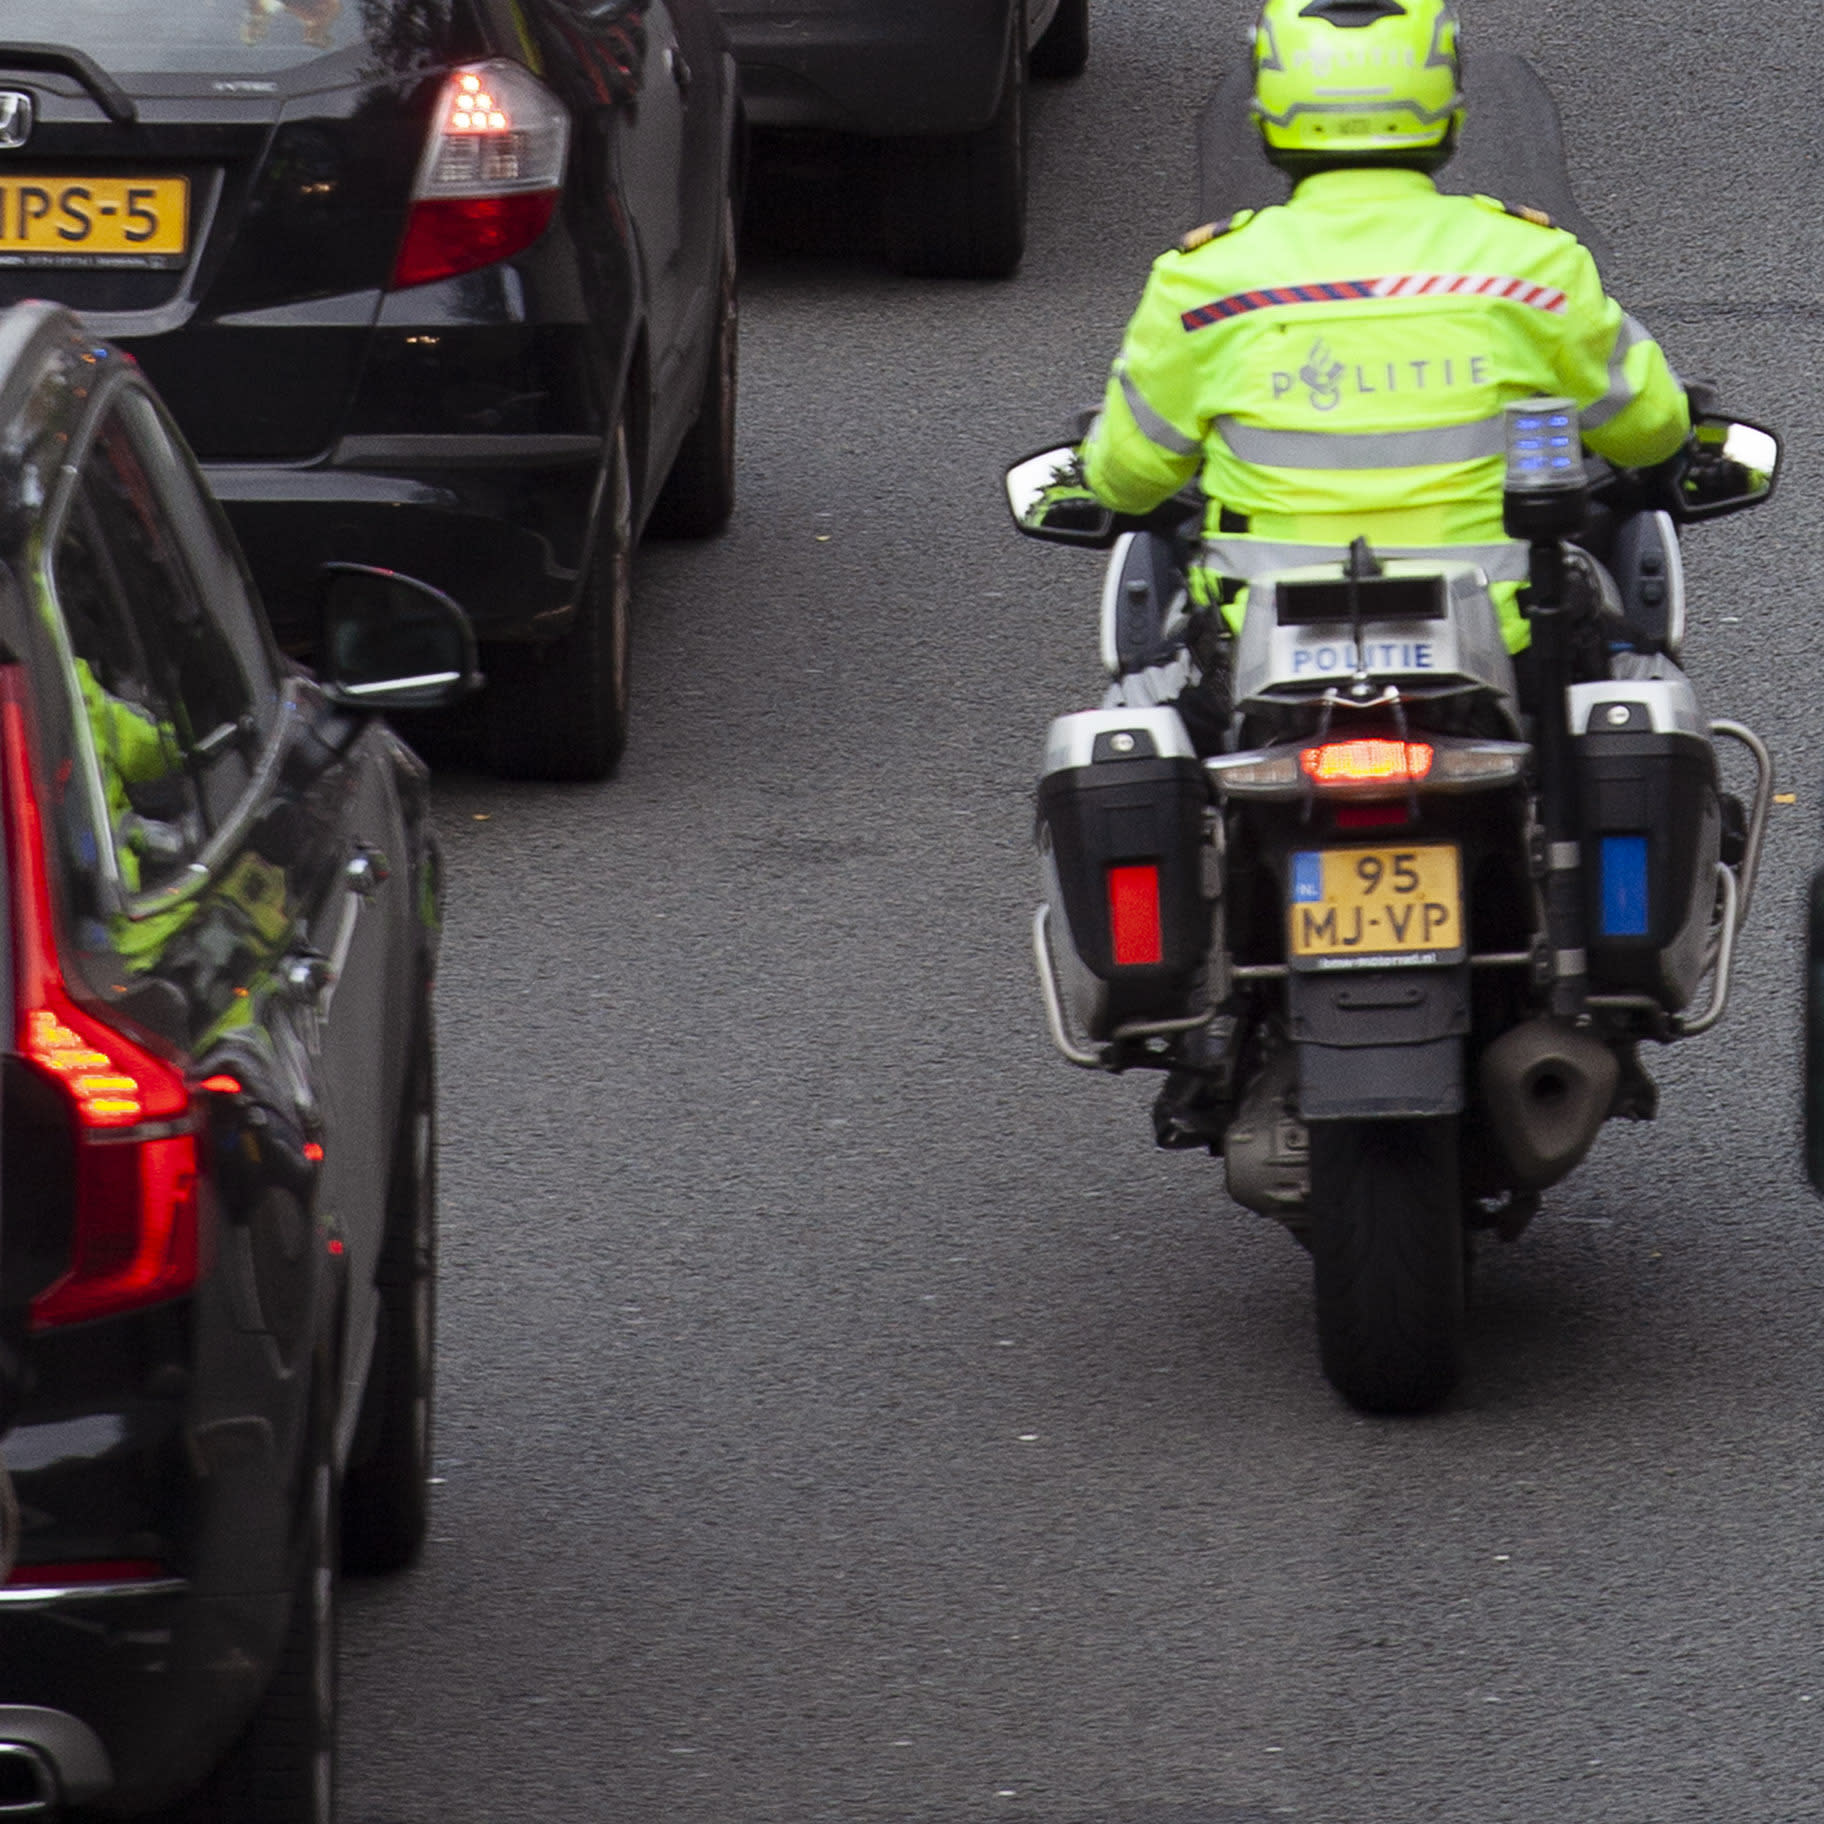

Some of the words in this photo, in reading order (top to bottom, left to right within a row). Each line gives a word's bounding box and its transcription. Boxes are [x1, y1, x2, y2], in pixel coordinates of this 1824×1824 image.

[0, 186, 159, 242] PS-5
[1293, 644, 1432, 673] POLITIE
[1356, 854, 1420, 895] 95
[1303, 903, 1449, 948] MJ-VP
